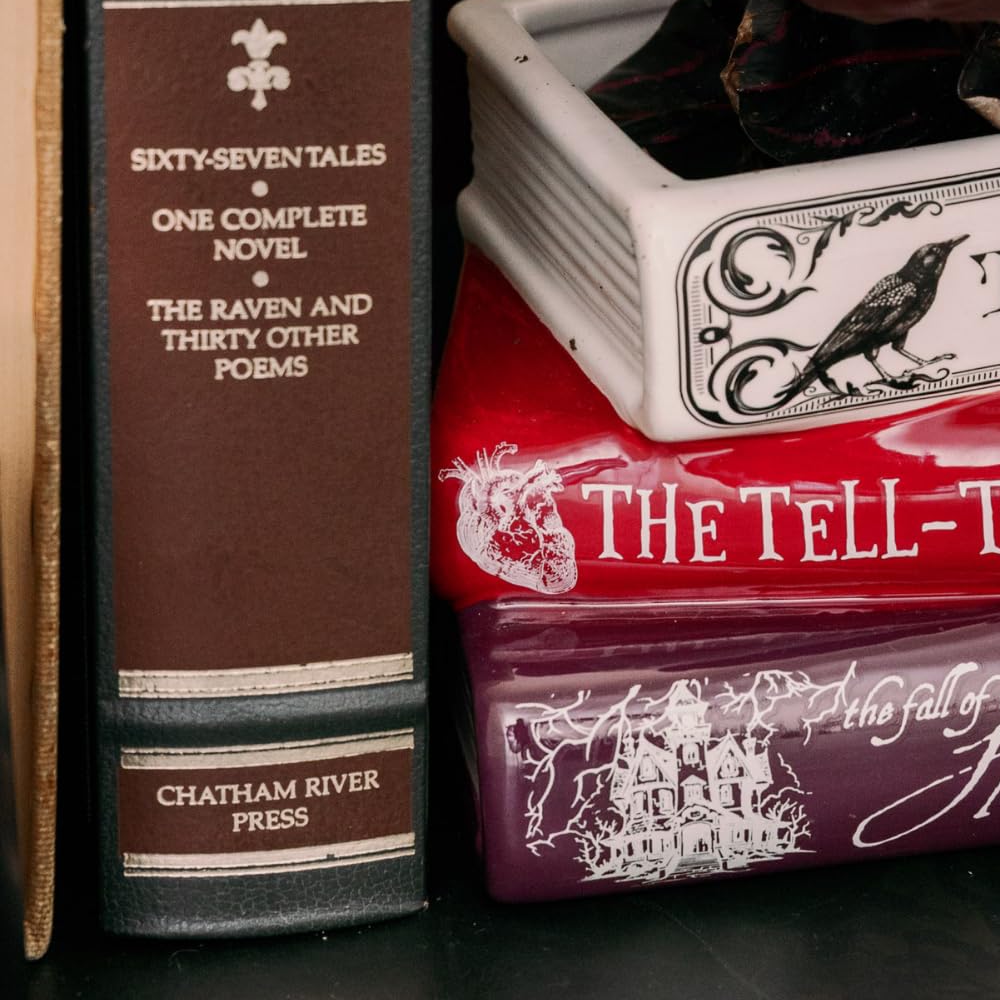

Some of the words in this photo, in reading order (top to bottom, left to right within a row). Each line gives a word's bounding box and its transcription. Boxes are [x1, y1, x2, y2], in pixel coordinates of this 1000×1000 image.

[130, 146, 302, 172] SIXTY-SEVEN
[302, 143, 387, 168] TALES
[152, 208, 214, 232] ONE
[220, 204, 367, 231] COMPLETE
[213, 237, 308, 261] NOVEL
[147, 299, 203, 322] THE
[209, 296, 302, 321] RAVEN
[309, 293, 373, 318] AND
[161, 328, 261, 351] THIRTY
[266, 324, 360, 349] OTHER
[214, 355, 309, 380] POEMS
[581, 482, 727, 564] THE
[843, 676, 904, 729] the
[870, 661, 979, 747] fall
[156, 780, 297, 806] CHATHAM
[304, 769, 380, 798] RIVER
[231, 807, 309, 833] PRESS
